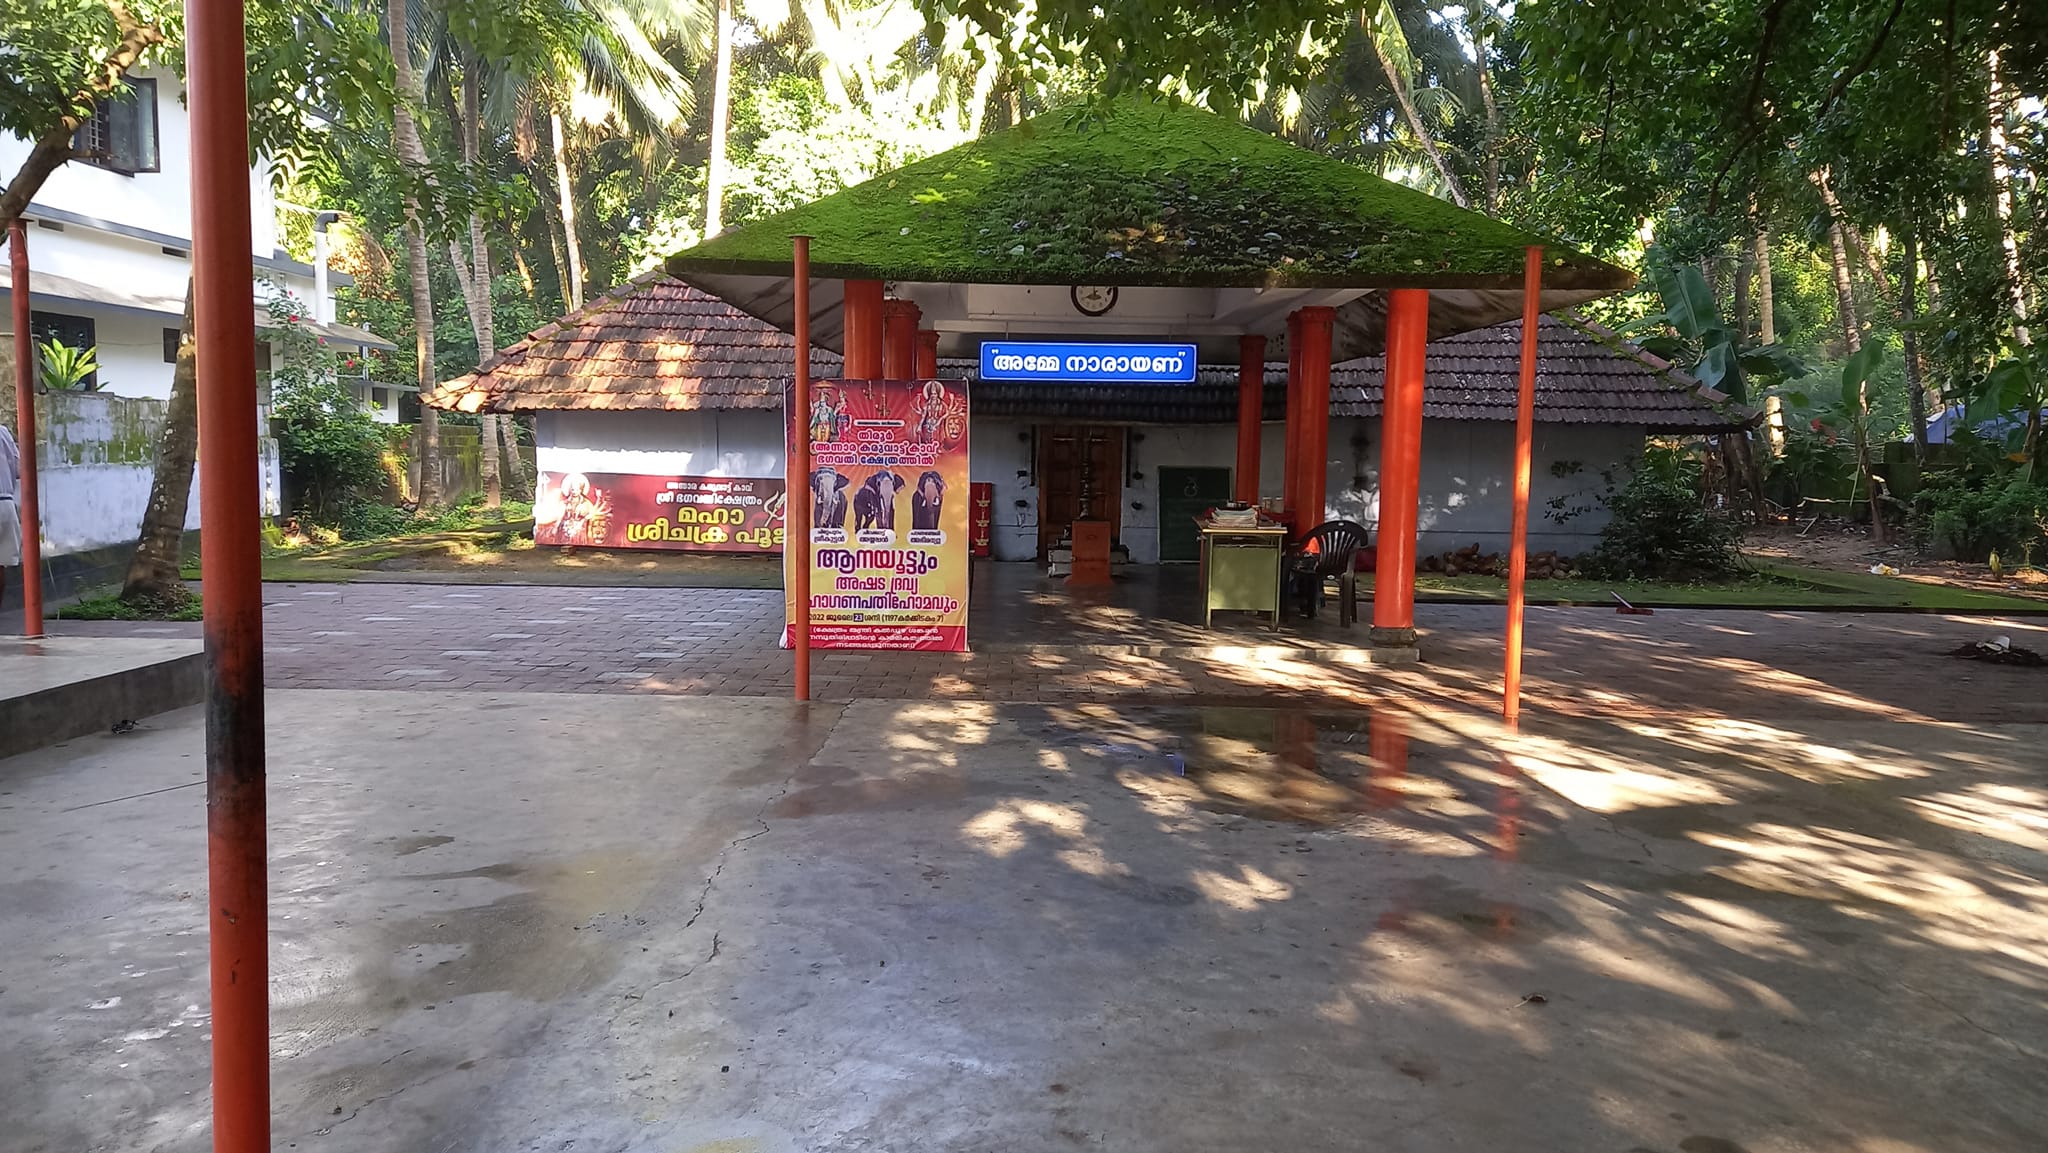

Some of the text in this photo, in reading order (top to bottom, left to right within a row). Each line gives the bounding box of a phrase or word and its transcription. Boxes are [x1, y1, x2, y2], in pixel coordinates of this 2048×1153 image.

[909, 441, 940, 453] കാവ്
[816, 454, 935, 467] ഭഗവതി ക്ഷേത്രത്തിൽ
[677, 506, 745, 525] മഹാ
[626, 516, 729, 544] ശ്രീചക്ര
[816, 548, 939, 575] ആനയൂട്ടും
[890, 577, 919, 595] ദ്രവ്യ
